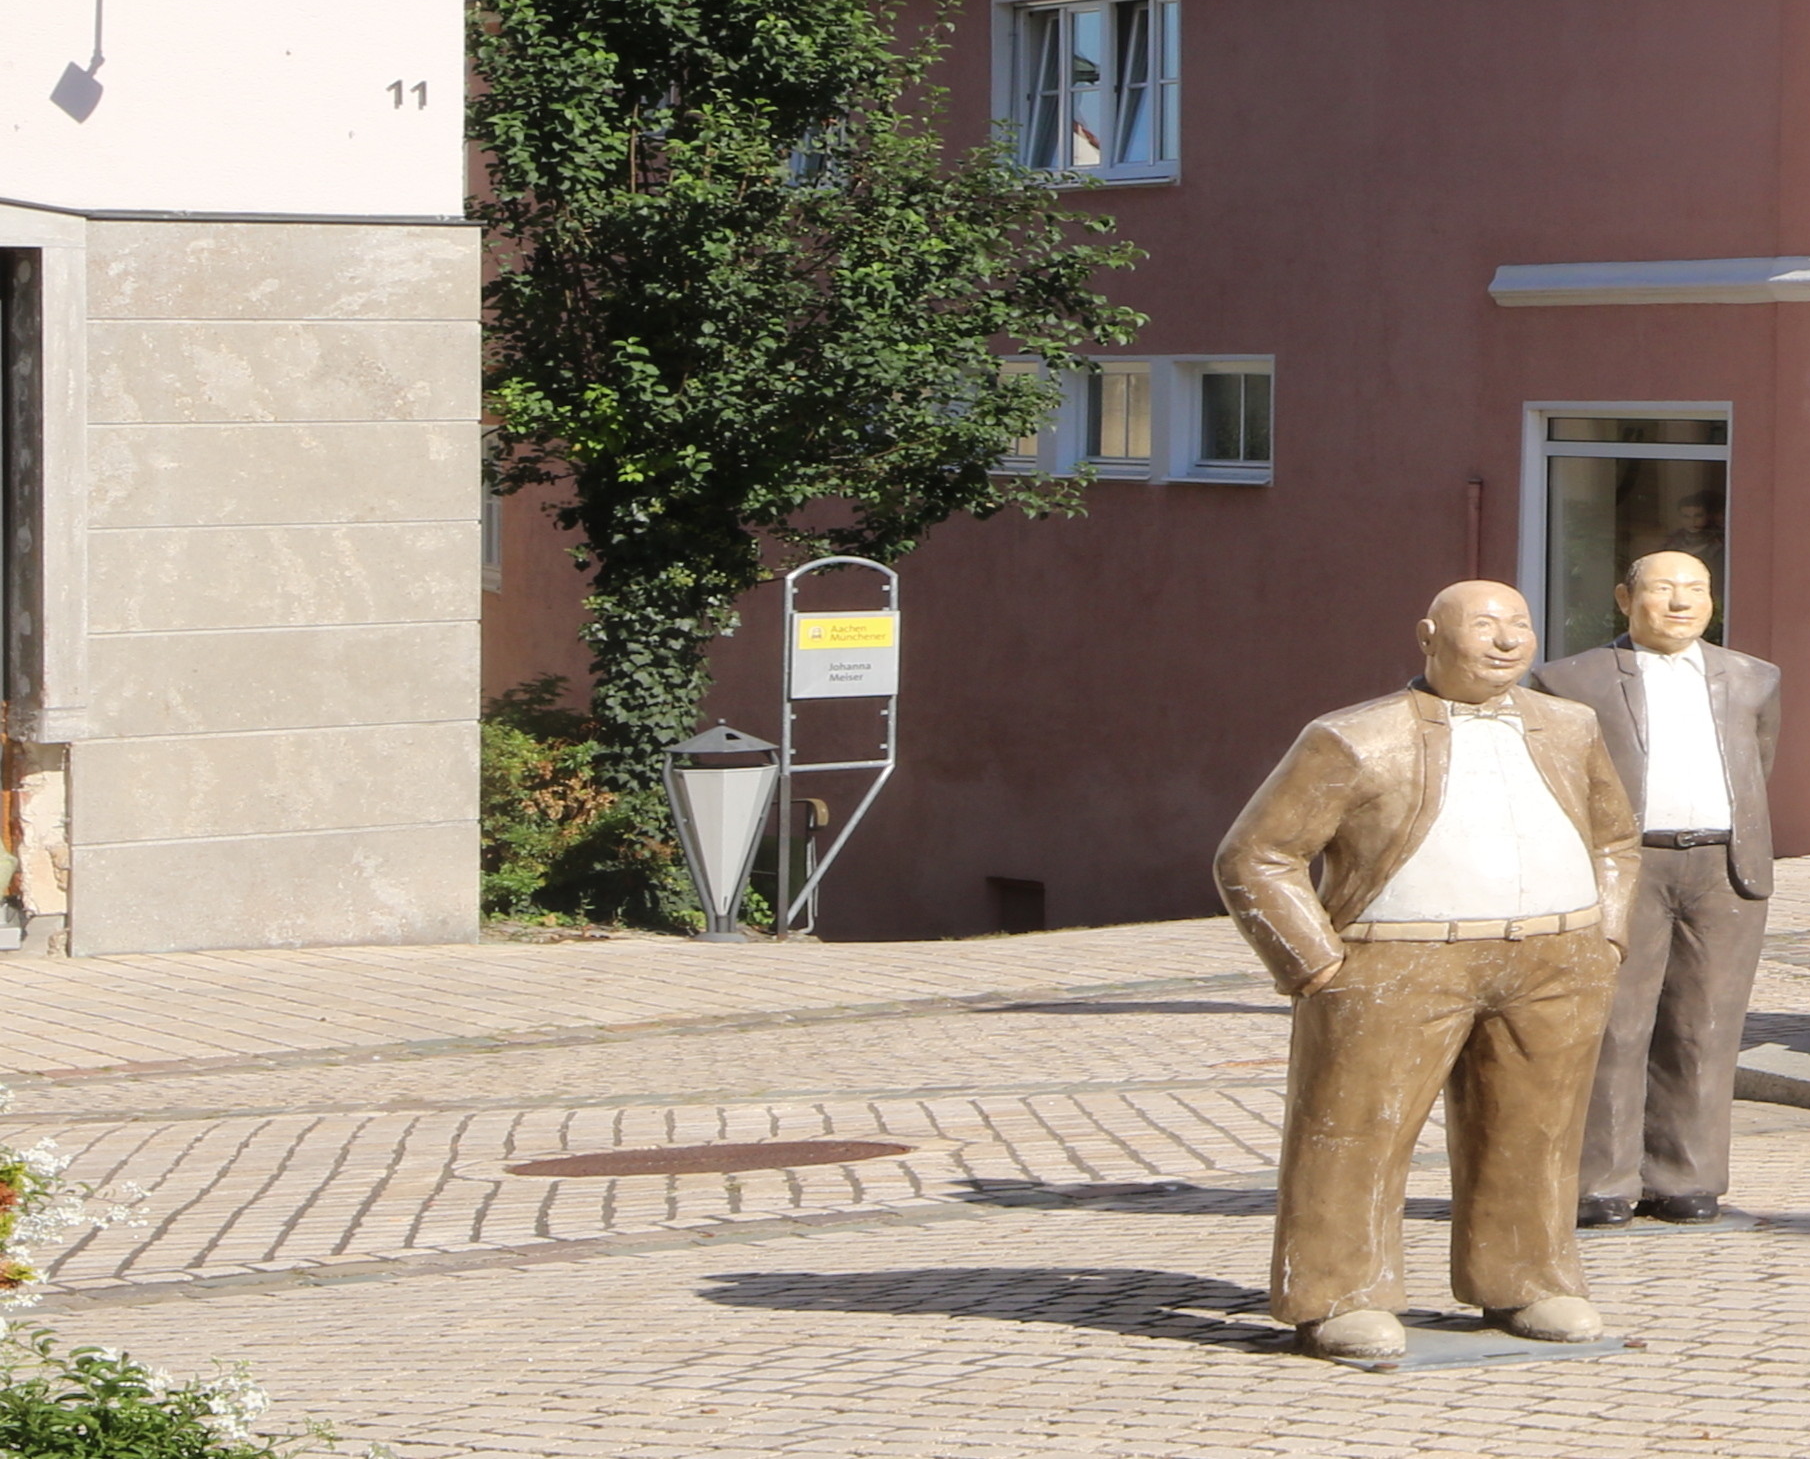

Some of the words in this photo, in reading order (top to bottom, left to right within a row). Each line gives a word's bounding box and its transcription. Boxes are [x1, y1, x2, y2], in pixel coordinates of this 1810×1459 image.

[386, 79, 427, 110] 11
[830, 625, 867, 633] Aachen
[829, 661, 872, 671] Johanna
[829, 672, 864, 682] Meiser
